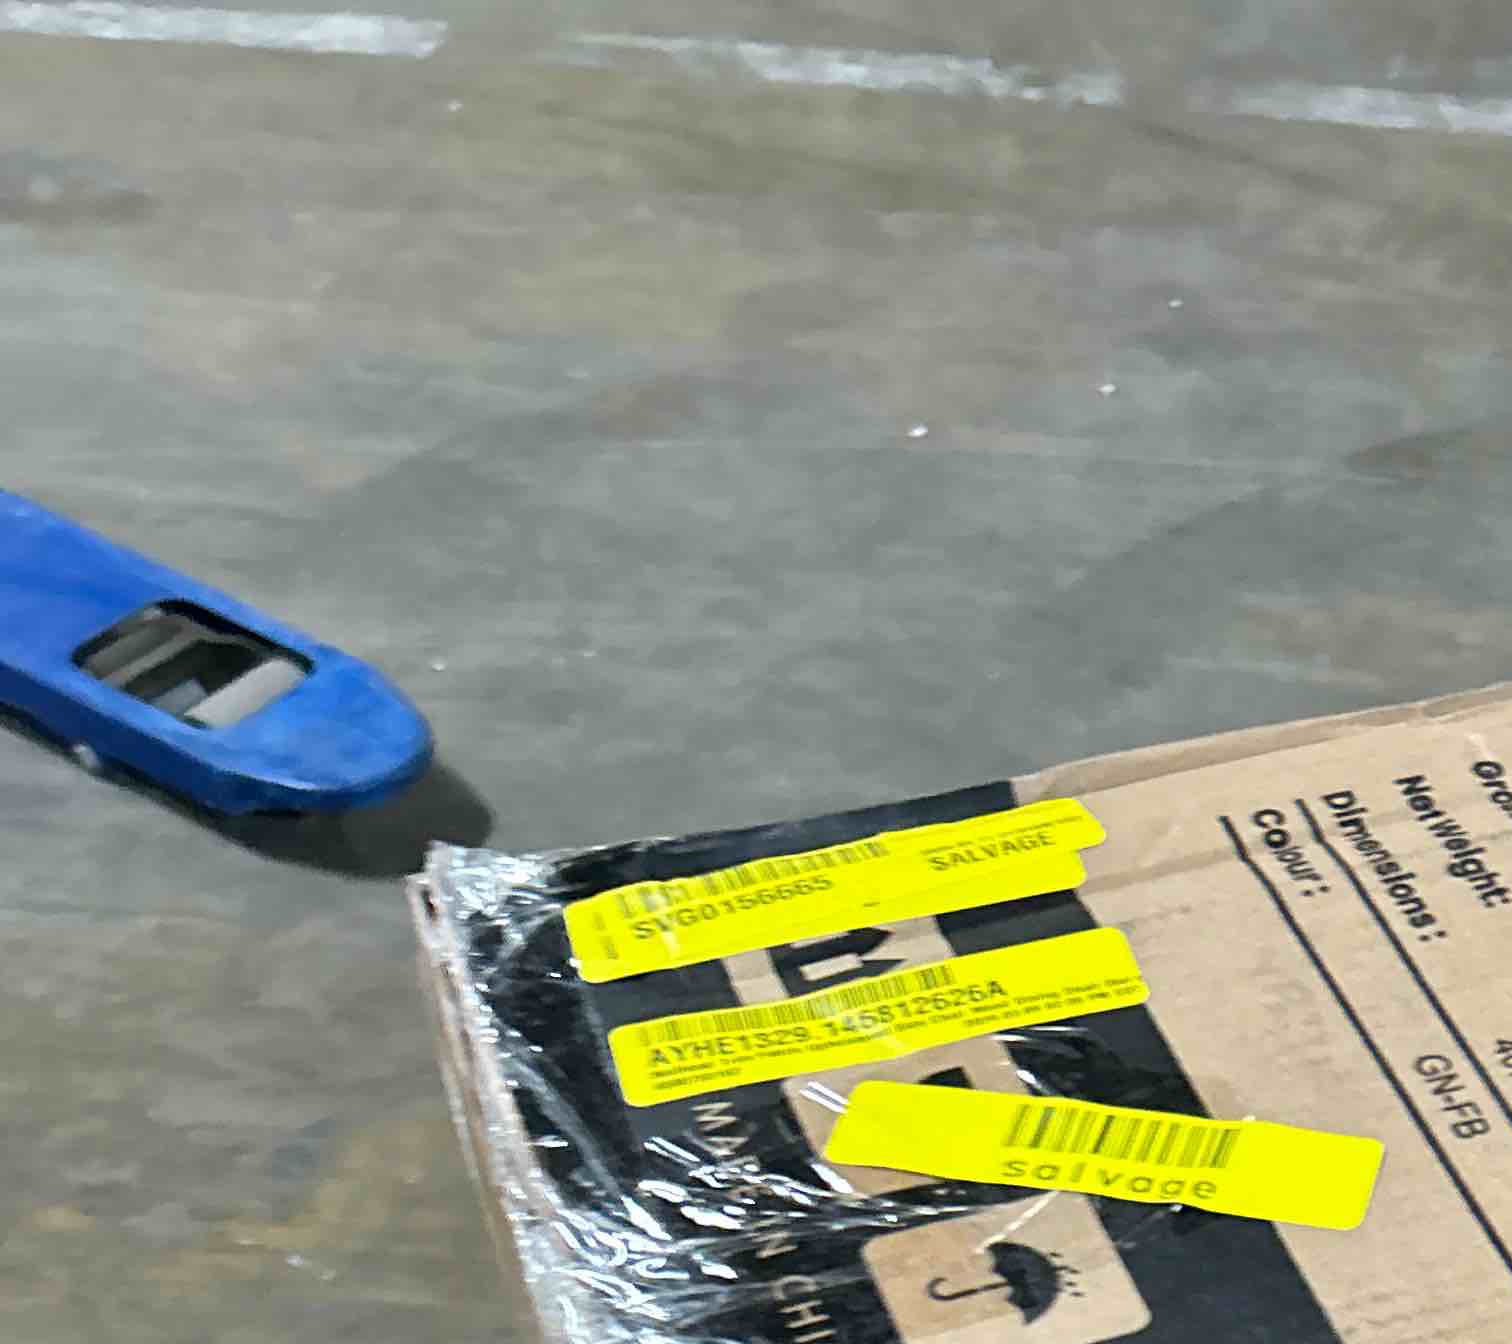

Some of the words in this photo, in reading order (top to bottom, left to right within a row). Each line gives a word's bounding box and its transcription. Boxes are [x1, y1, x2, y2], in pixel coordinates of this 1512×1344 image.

[1391, 774, 1447, 823] Net
[928, 831, 1057, 873] SALVAGE
[1412, 1053, 1492, 1141] GN-FB
[688, 1101, 772, 1205] MA
[1000, 1159, 1218, 1200] salvage
